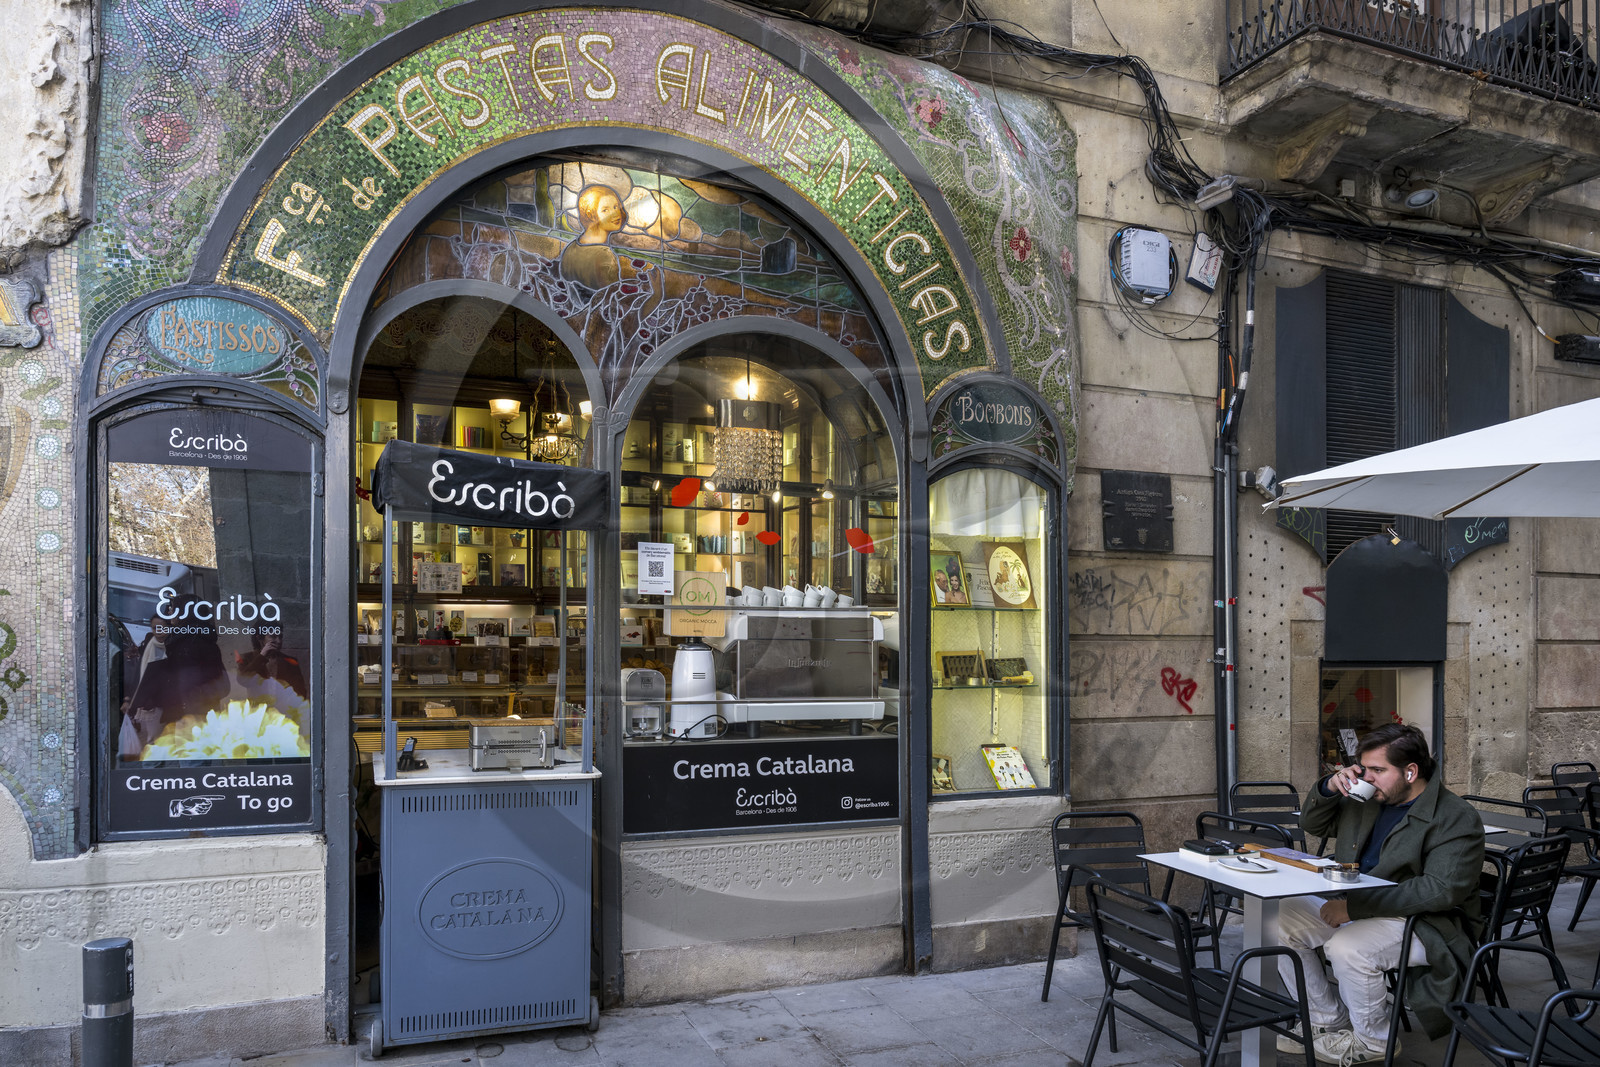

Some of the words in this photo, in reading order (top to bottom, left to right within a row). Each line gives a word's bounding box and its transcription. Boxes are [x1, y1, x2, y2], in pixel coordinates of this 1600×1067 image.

[343, 31, 617, 178] PASTAS
[342, 177, 383, 210] de
[655, 42, 972, 360] ALIMENTICIAS
[160, 305, 281, 362] PASTISSOS
[955, 391, 1032, 427] BOMBONS
[169, 427, 248, 452] Escribà
[169, 450, 203, 459] Barcelona
[207, 452, 222, 460] Des
[222, 453, 232, 461] de
[428, 459, 576, 519] Escribà
[156, 586, 281, 622] Escribà
[686, 590, 711, 603] OM
[155, 624, 210, 635] Barcelona
[218, 625, 239, 635] Des
[241, 625, 257, 635] de
[258, 626, 281, 636] 1906
[673, 759, 750, 780] Crema
[756, 754, 855, 776] Catalana
[125, 775, 197, 791] Crema
[202, 771, 293, 788] Catalana
[237, 795, 263, 810] To
[266, 796, 293, 813] go
[736, 787, 798, 807] Escribà
[450, 888, 529, 909] CREMA
[430, 907, 548, 931] CATALANA
